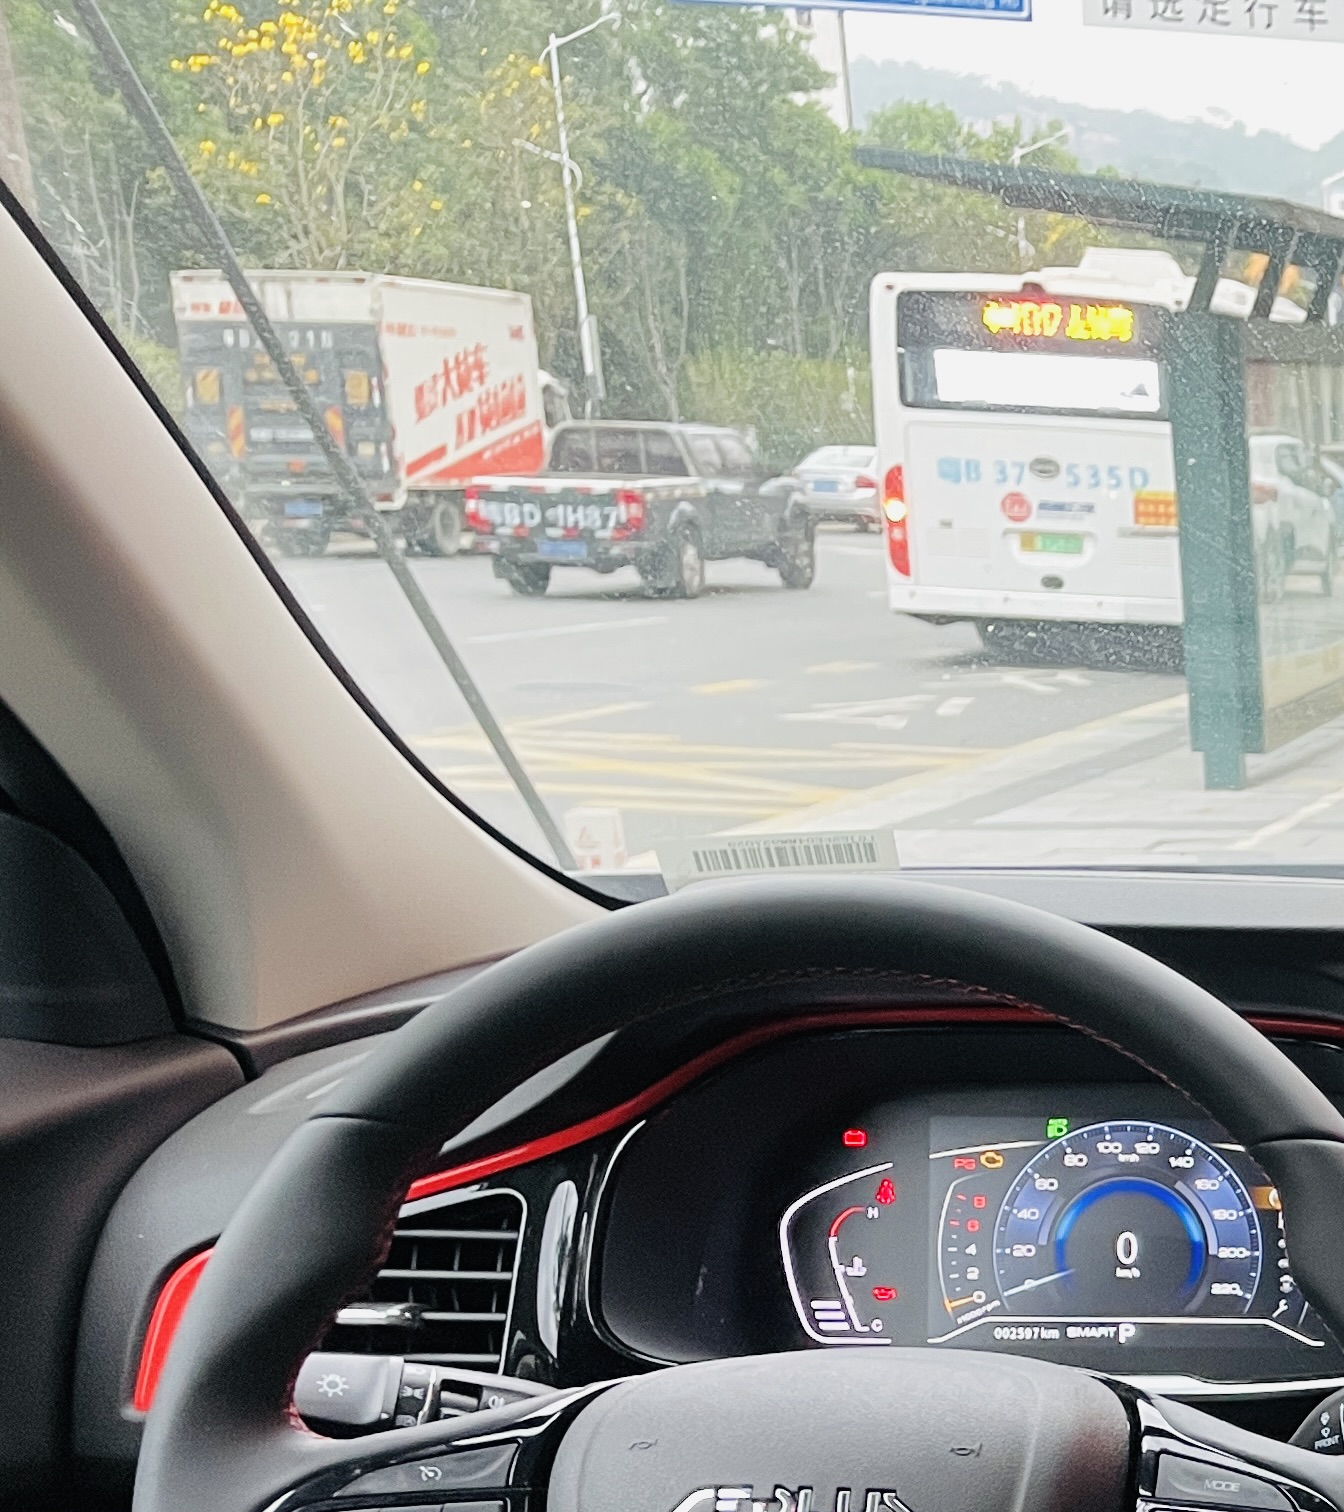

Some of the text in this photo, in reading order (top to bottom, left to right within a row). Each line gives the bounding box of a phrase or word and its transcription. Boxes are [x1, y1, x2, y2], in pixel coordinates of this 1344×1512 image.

[1066, 463, 1149, 490] 535D
[1097, 1142, 1122, 1154] 100
[1063, 1153, 1088, 1167] 80
[1168, 1156, 1194, 1169] 140
[866, 1206, 880, 1219] H
[1017, 1208, 1039, 1220] 40
[964, 1243, 977, 1256] 4
[1012, 1244, 1036, 1257] 20
[1115, 1231, 1138, 1265] 0
[1218, 1247, 1244, 1258] 200
[966, 1267, 980, 1281] 2
[1066, 1326, 1116, 1340] SMART
[1117, 1322, 1136, 1343] P
[1203, 1478, 1241, 1493] MODE
